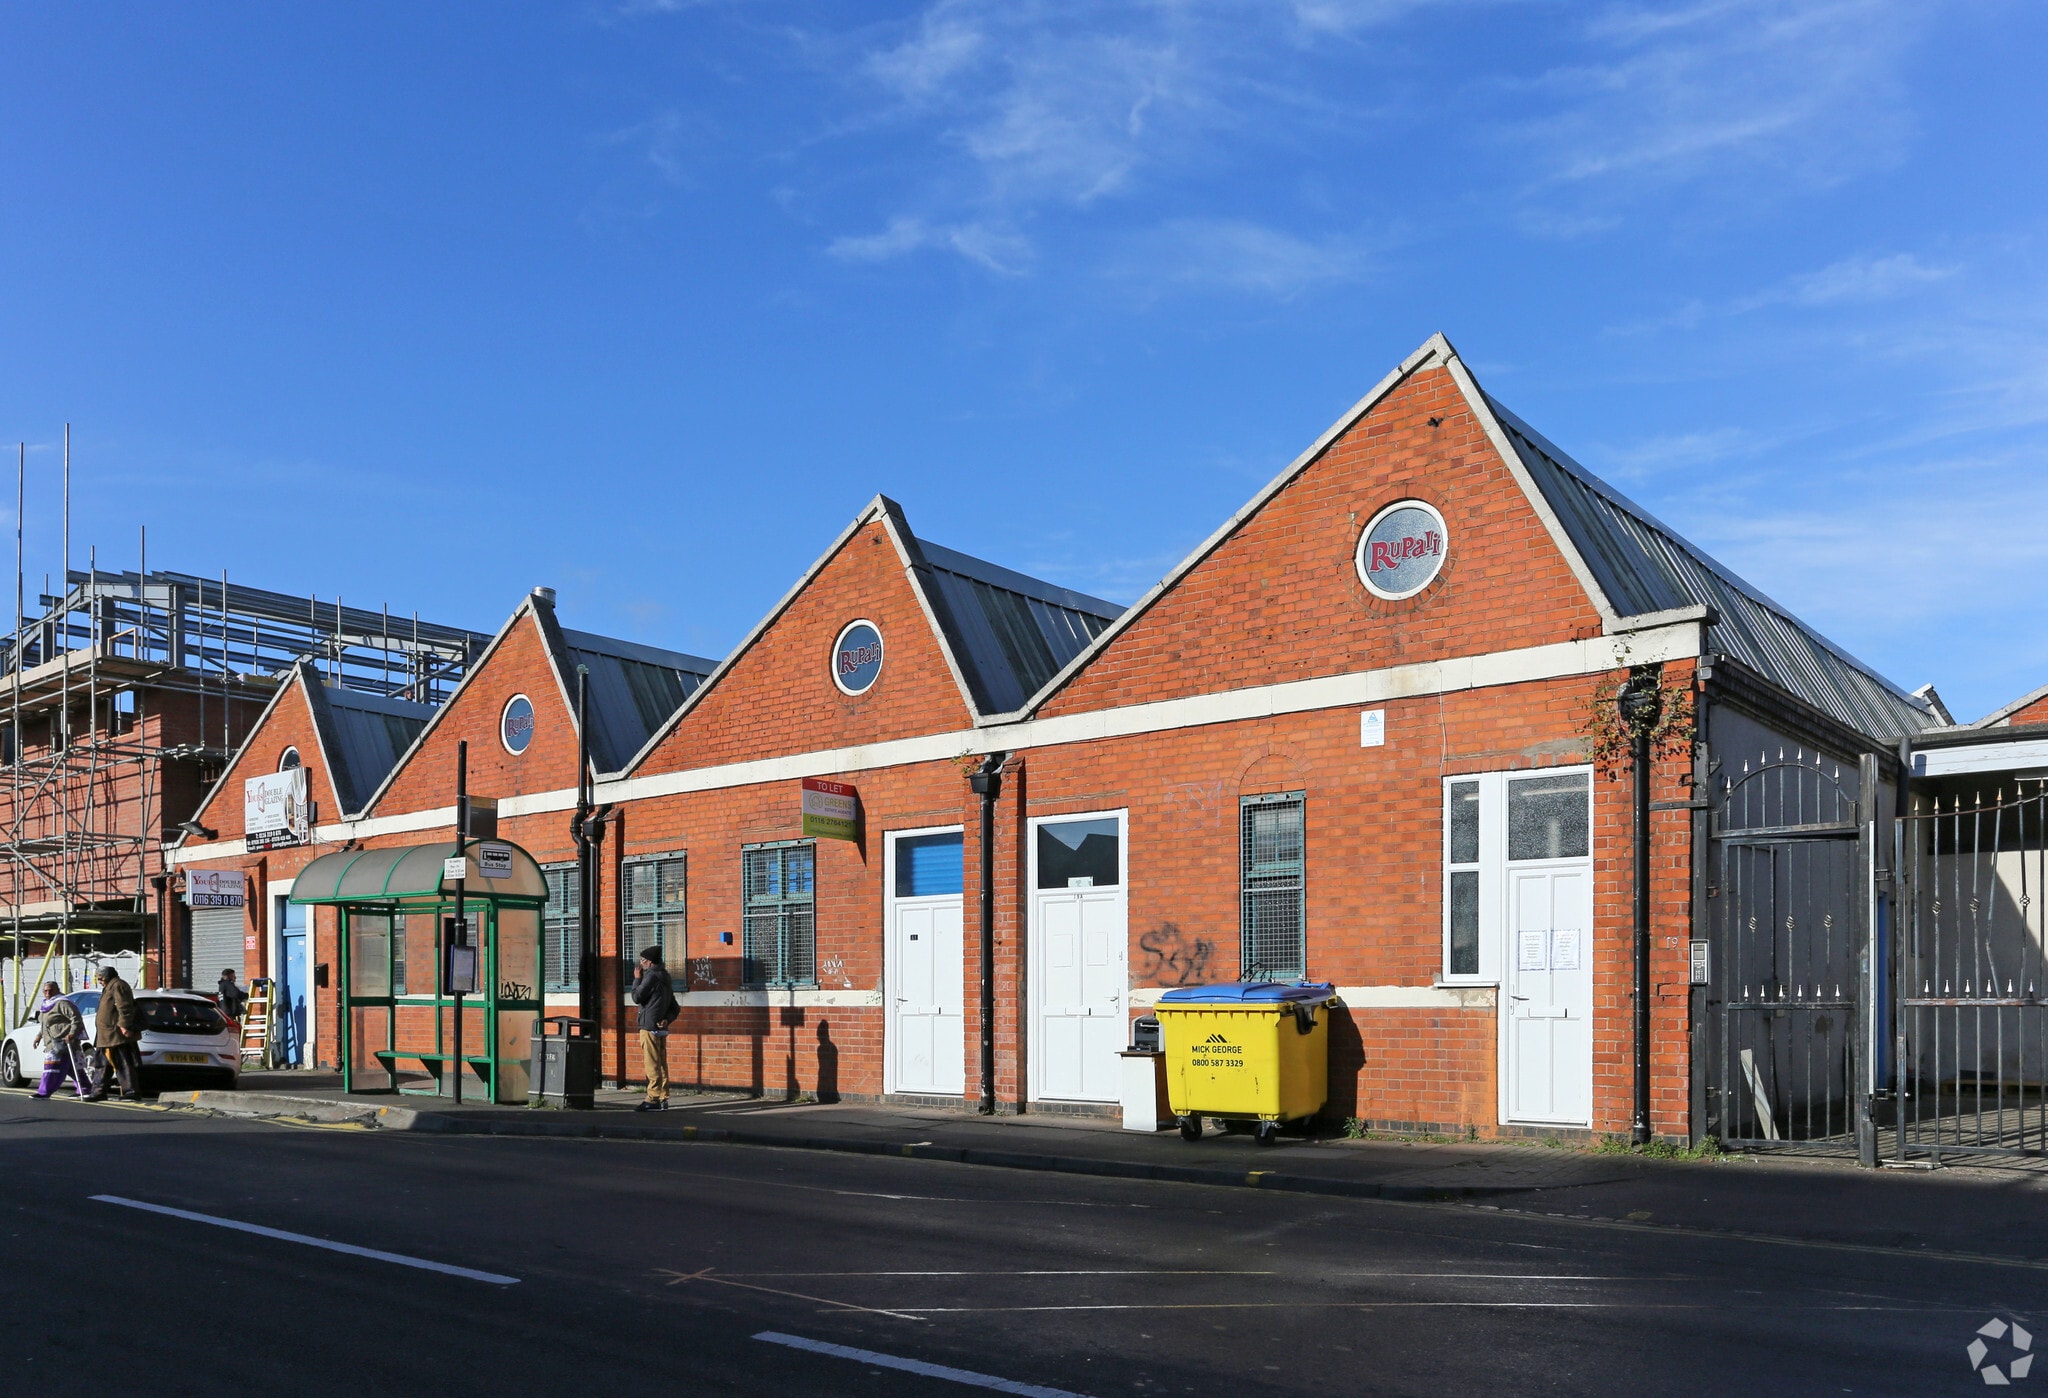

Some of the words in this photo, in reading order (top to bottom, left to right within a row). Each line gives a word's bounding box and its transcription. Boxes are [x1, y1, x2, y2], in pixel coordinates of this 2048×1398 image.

[817, 782, 828, 790] TO
[830, 784, 843, 793] LET
[825, 797, 852, 809] GREENS
[194, 894, 209, 905] 0116
[210, 895, 222, 905] 319
[223, 895, 229, 906] 0
[230, 895, 242, 906] 870
[1191, 1045, 1210, 1053] MICK
[1211, 1045, 1242, 1054] GEORGE
[1211, 1059, 1224, 1067] 587
[1226, 1059, 1243, 1067] 3329
